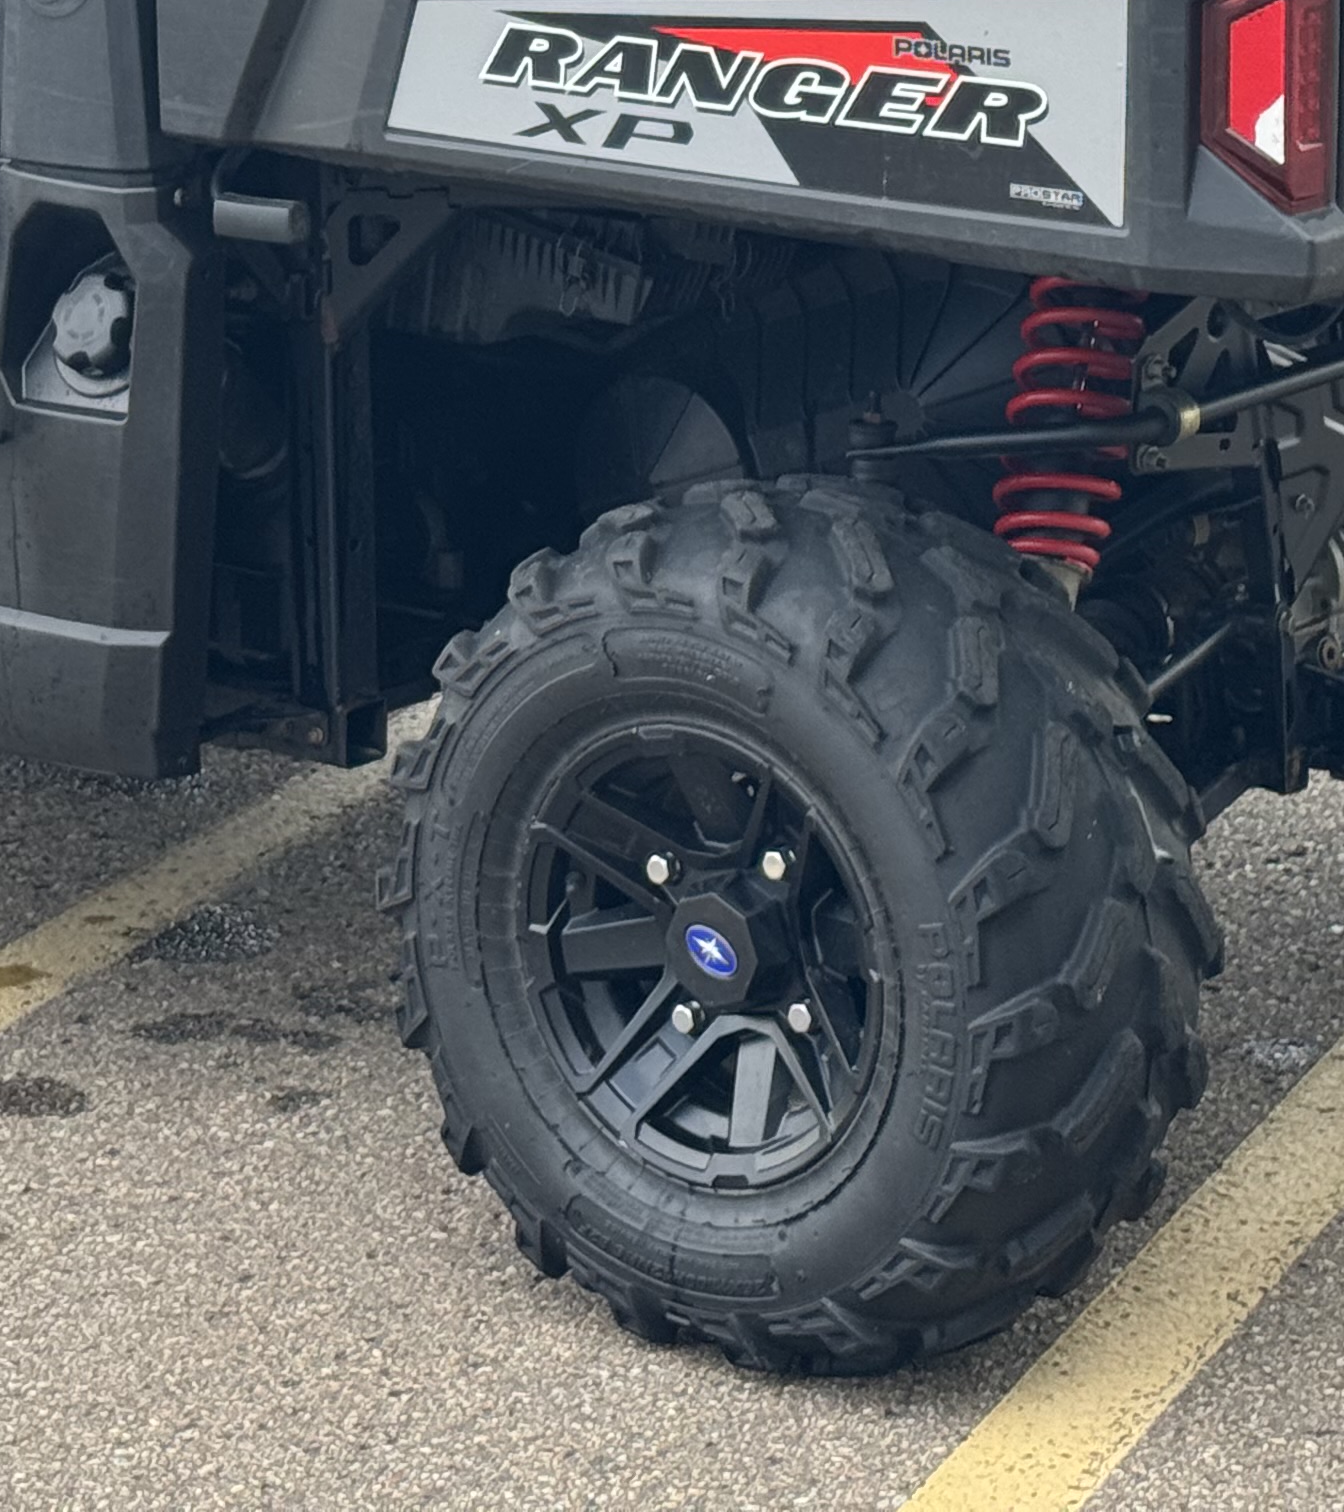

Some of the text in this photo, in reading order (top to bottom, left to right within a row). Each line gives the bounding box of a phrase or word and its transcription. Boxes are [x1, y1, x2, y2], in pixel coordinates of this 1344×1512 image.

[479, 21, 1049, 149] RANGER
[893, 36, 1012, 68] POLARIS
[514, 101, 694, 149] XP
[913, 922, 958, 1150] POLARIS
